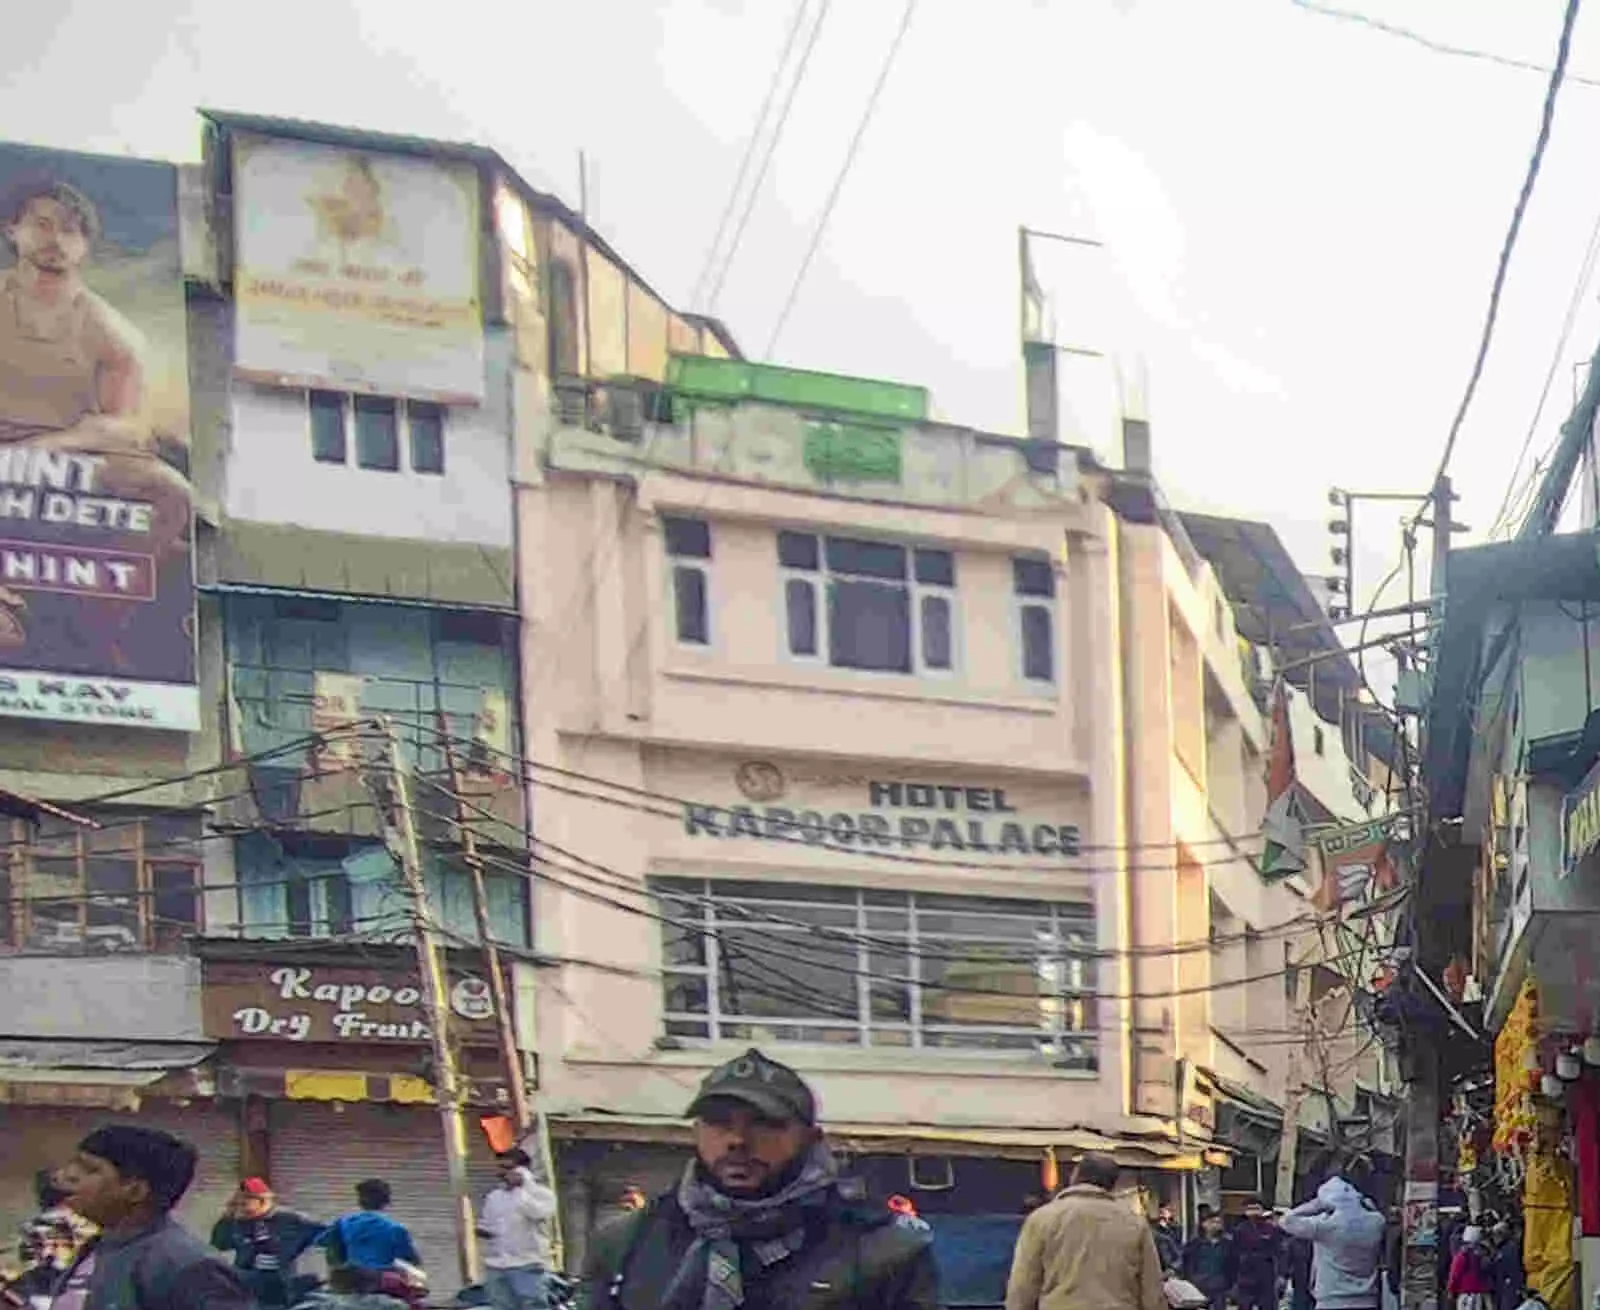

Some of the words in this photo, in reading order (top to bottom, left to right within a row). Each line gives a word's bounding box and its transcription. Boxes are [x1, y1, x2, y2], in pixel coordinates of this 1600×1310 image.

[869, 780, 1017, 813] HOTEL
[681, 804, 892, 847] KAPOOR
[898, 816, 1081, 857] PALACE
[270, 967, 426, 1011] Kapoo
[232, 1006, 312, 1040] Dry
